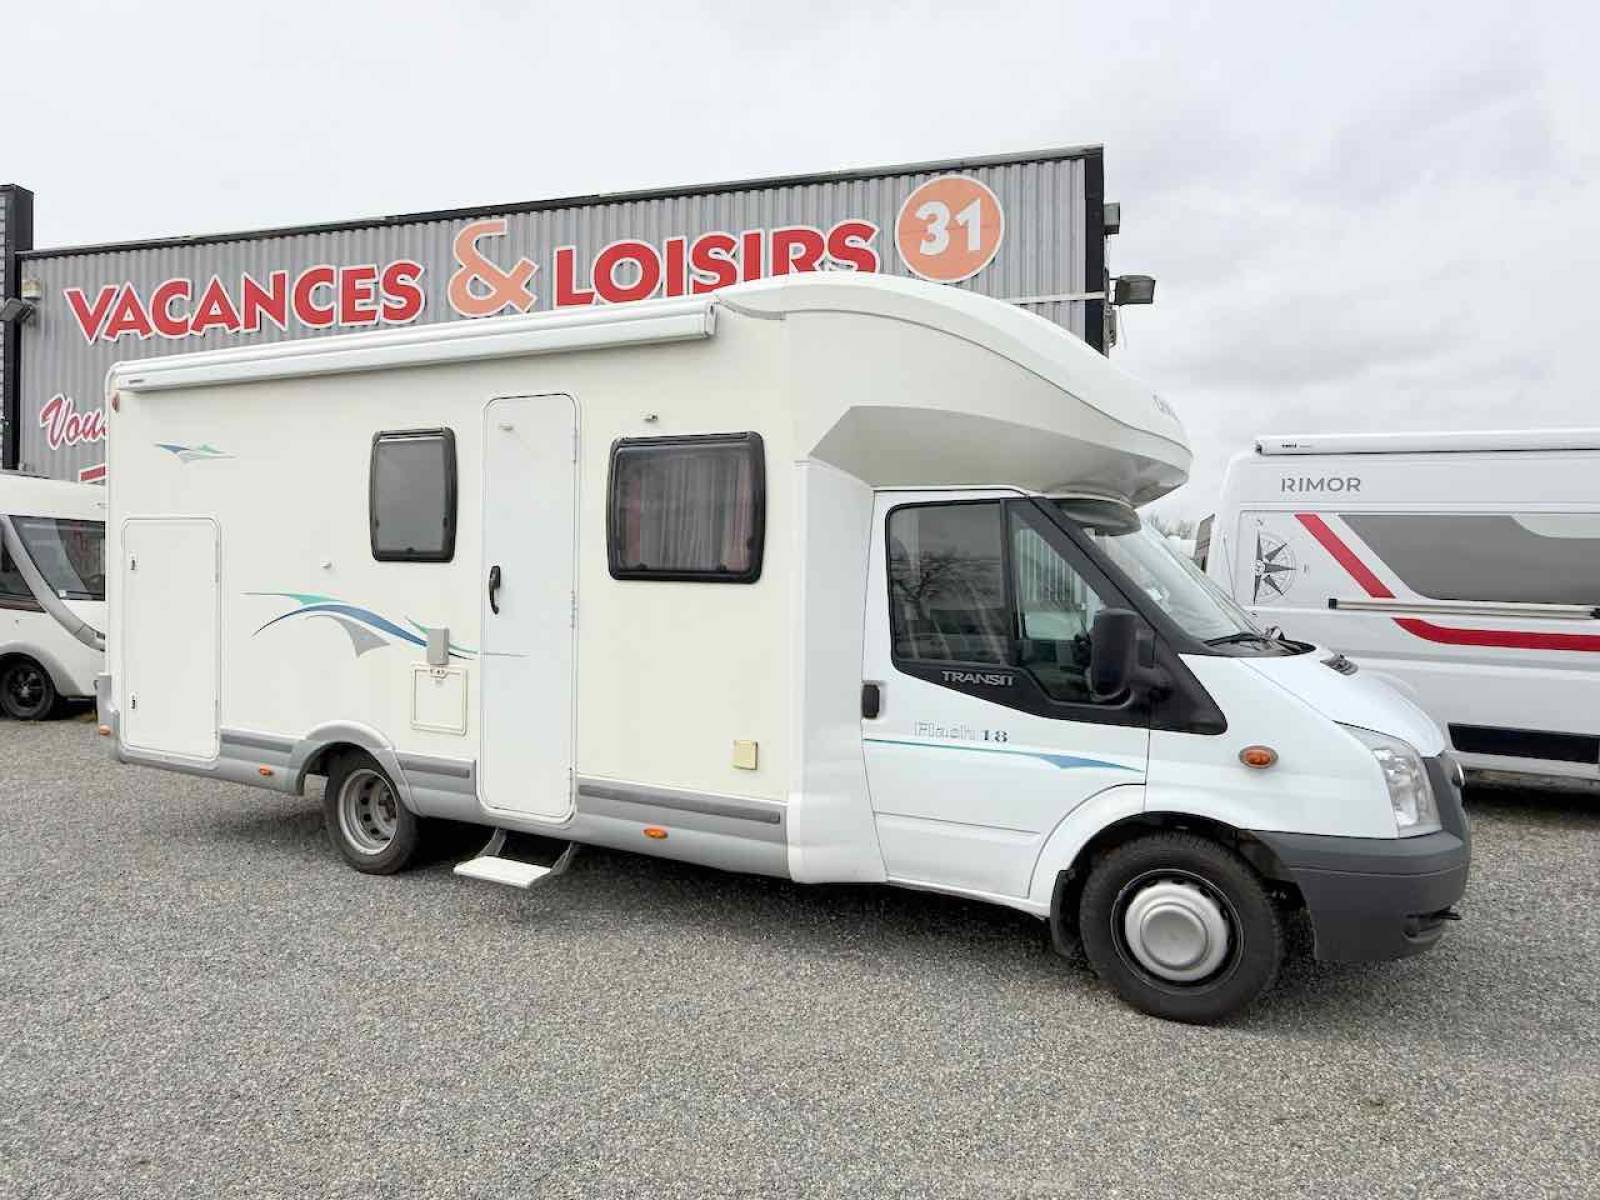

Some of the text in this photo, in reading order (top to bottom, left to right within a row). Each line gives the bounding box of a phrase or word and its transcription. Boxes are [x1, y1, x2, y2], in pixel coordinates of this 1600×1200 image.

[63, 199, 984, 344] VACANCES & LOISIRS 31
[1281, 476, 1361, 492] RIMOR
[941, 670, 1015, 687] TRANSIT
[983, 729, 1008, 742] 18
